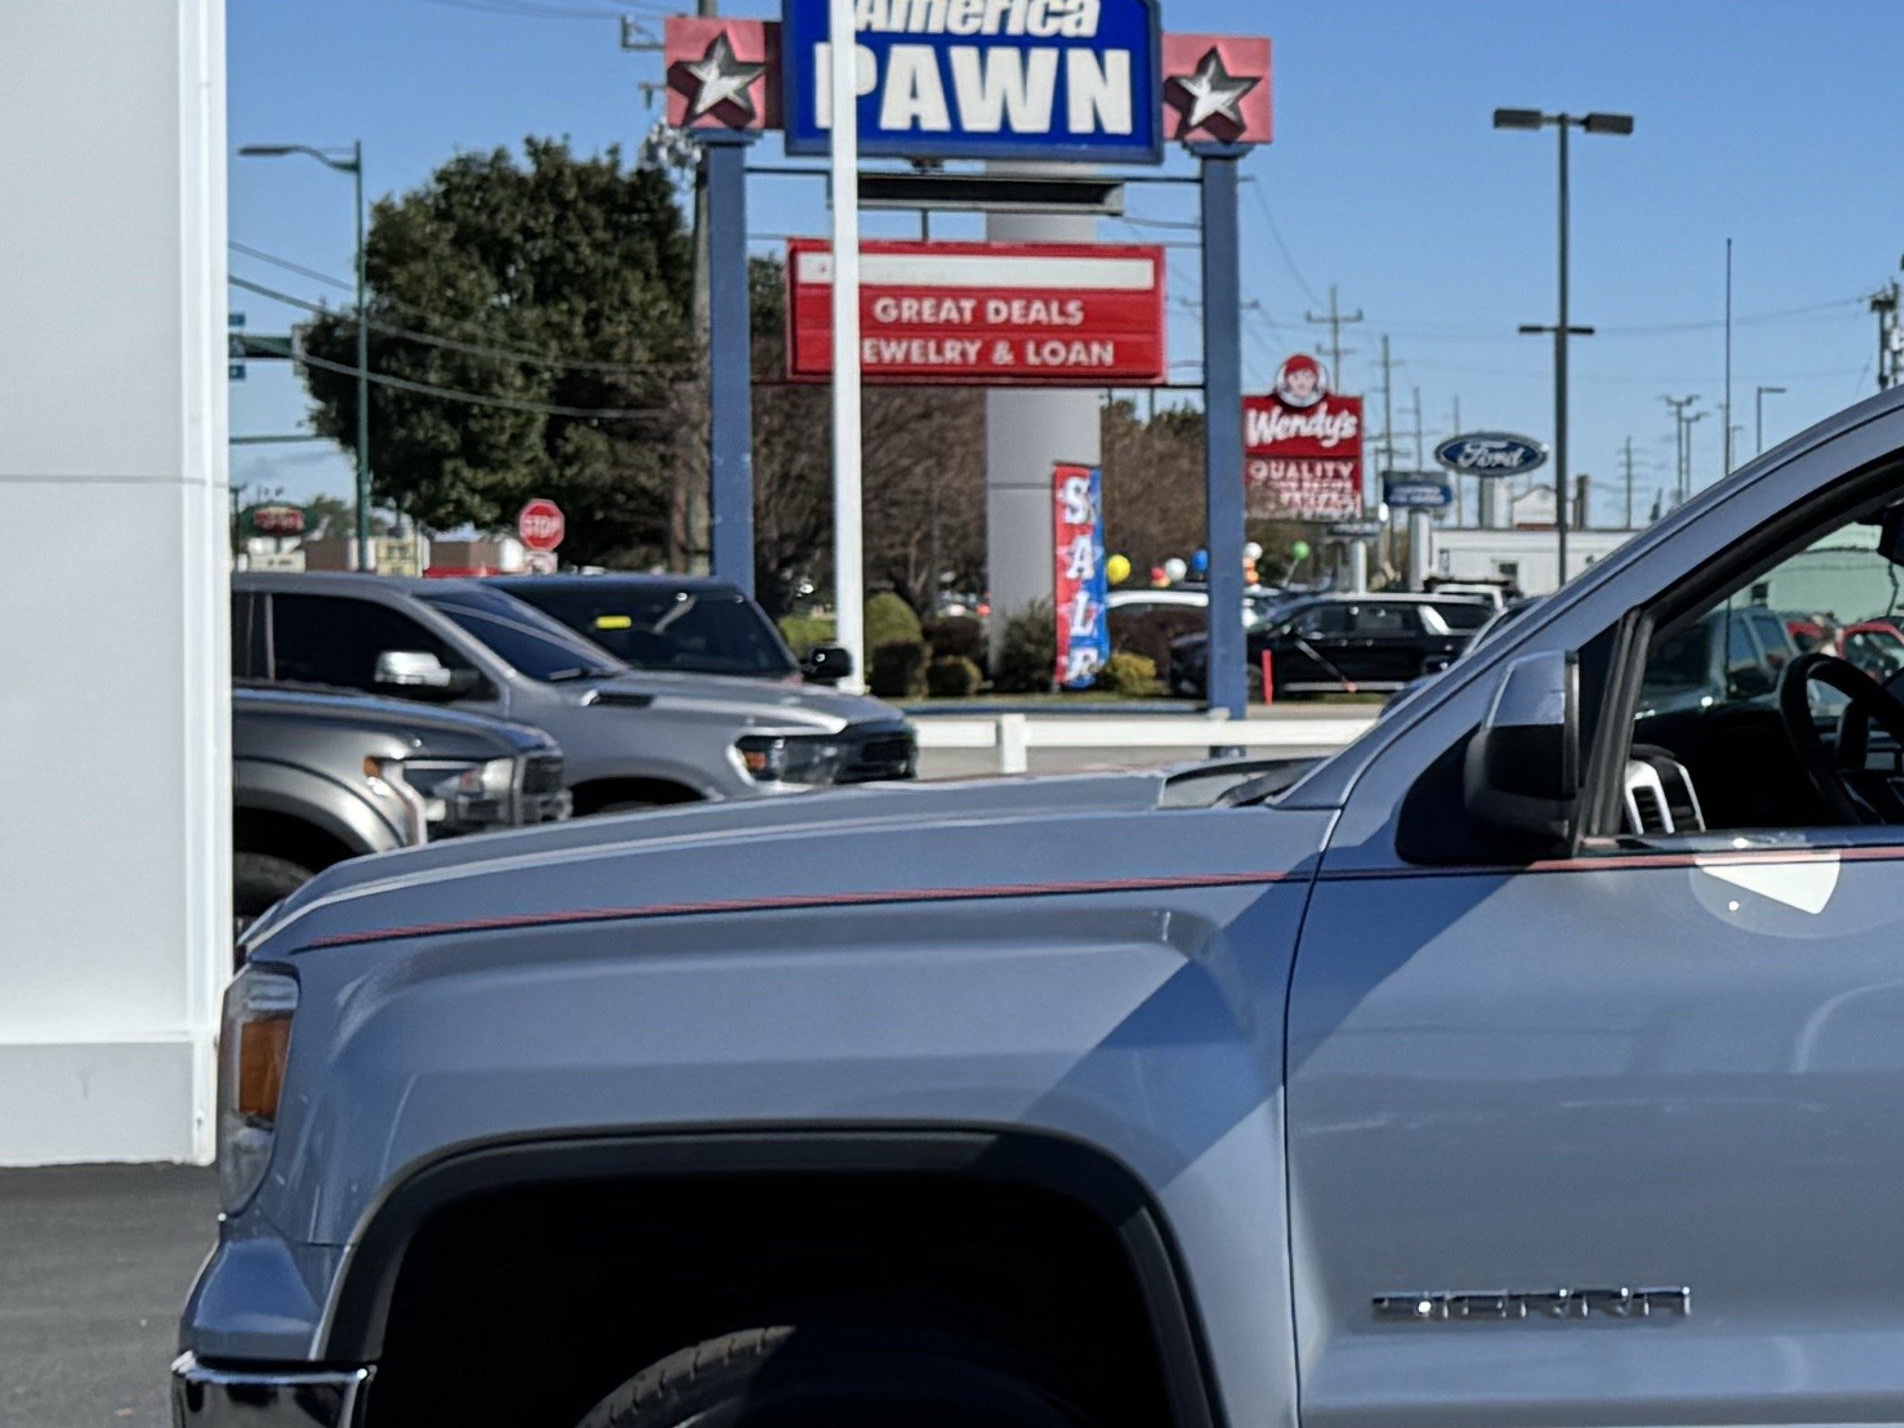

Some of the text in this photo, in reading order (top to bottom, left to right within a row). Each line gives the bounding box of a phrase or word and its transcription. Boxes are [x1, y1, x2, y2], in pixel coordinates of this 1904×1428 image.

[815, 42, 1133, 135] PAWN
[873, 297, 1084, 326] GREAT DEALS
[861, 338, 1115, 368] EWELRY & LOAN
[1246, 401, 1359, 448] Wendy's
[1458, 440, 1526, 469] Ford
[1249, 459, 1355, 481] QUALITY
[523, 514, 560, 539] STOP
[1372, 1288, 1693, 1323] SIERRA
